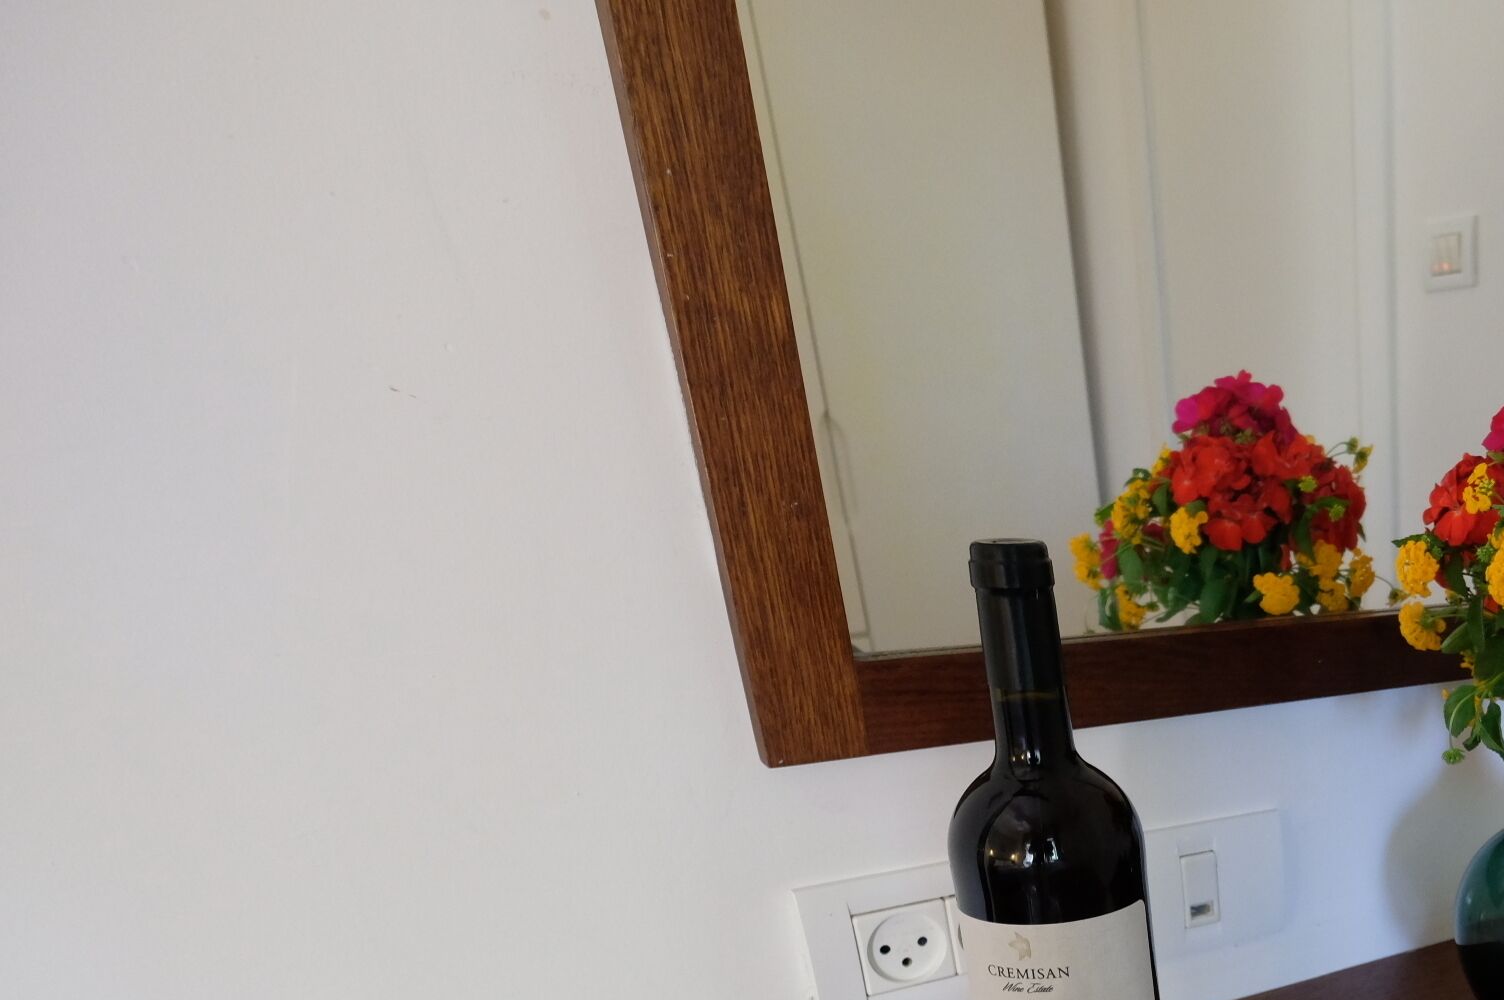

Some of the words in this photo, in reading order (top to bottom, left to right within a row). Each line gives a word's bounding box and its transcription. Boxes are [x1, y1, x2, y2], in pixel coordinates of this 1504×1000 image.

[988, 964, 1070, 980] CREMISAN
[1002, 982, 1026, 993] Wine
[1027, 983, 1055, 994] Estate
